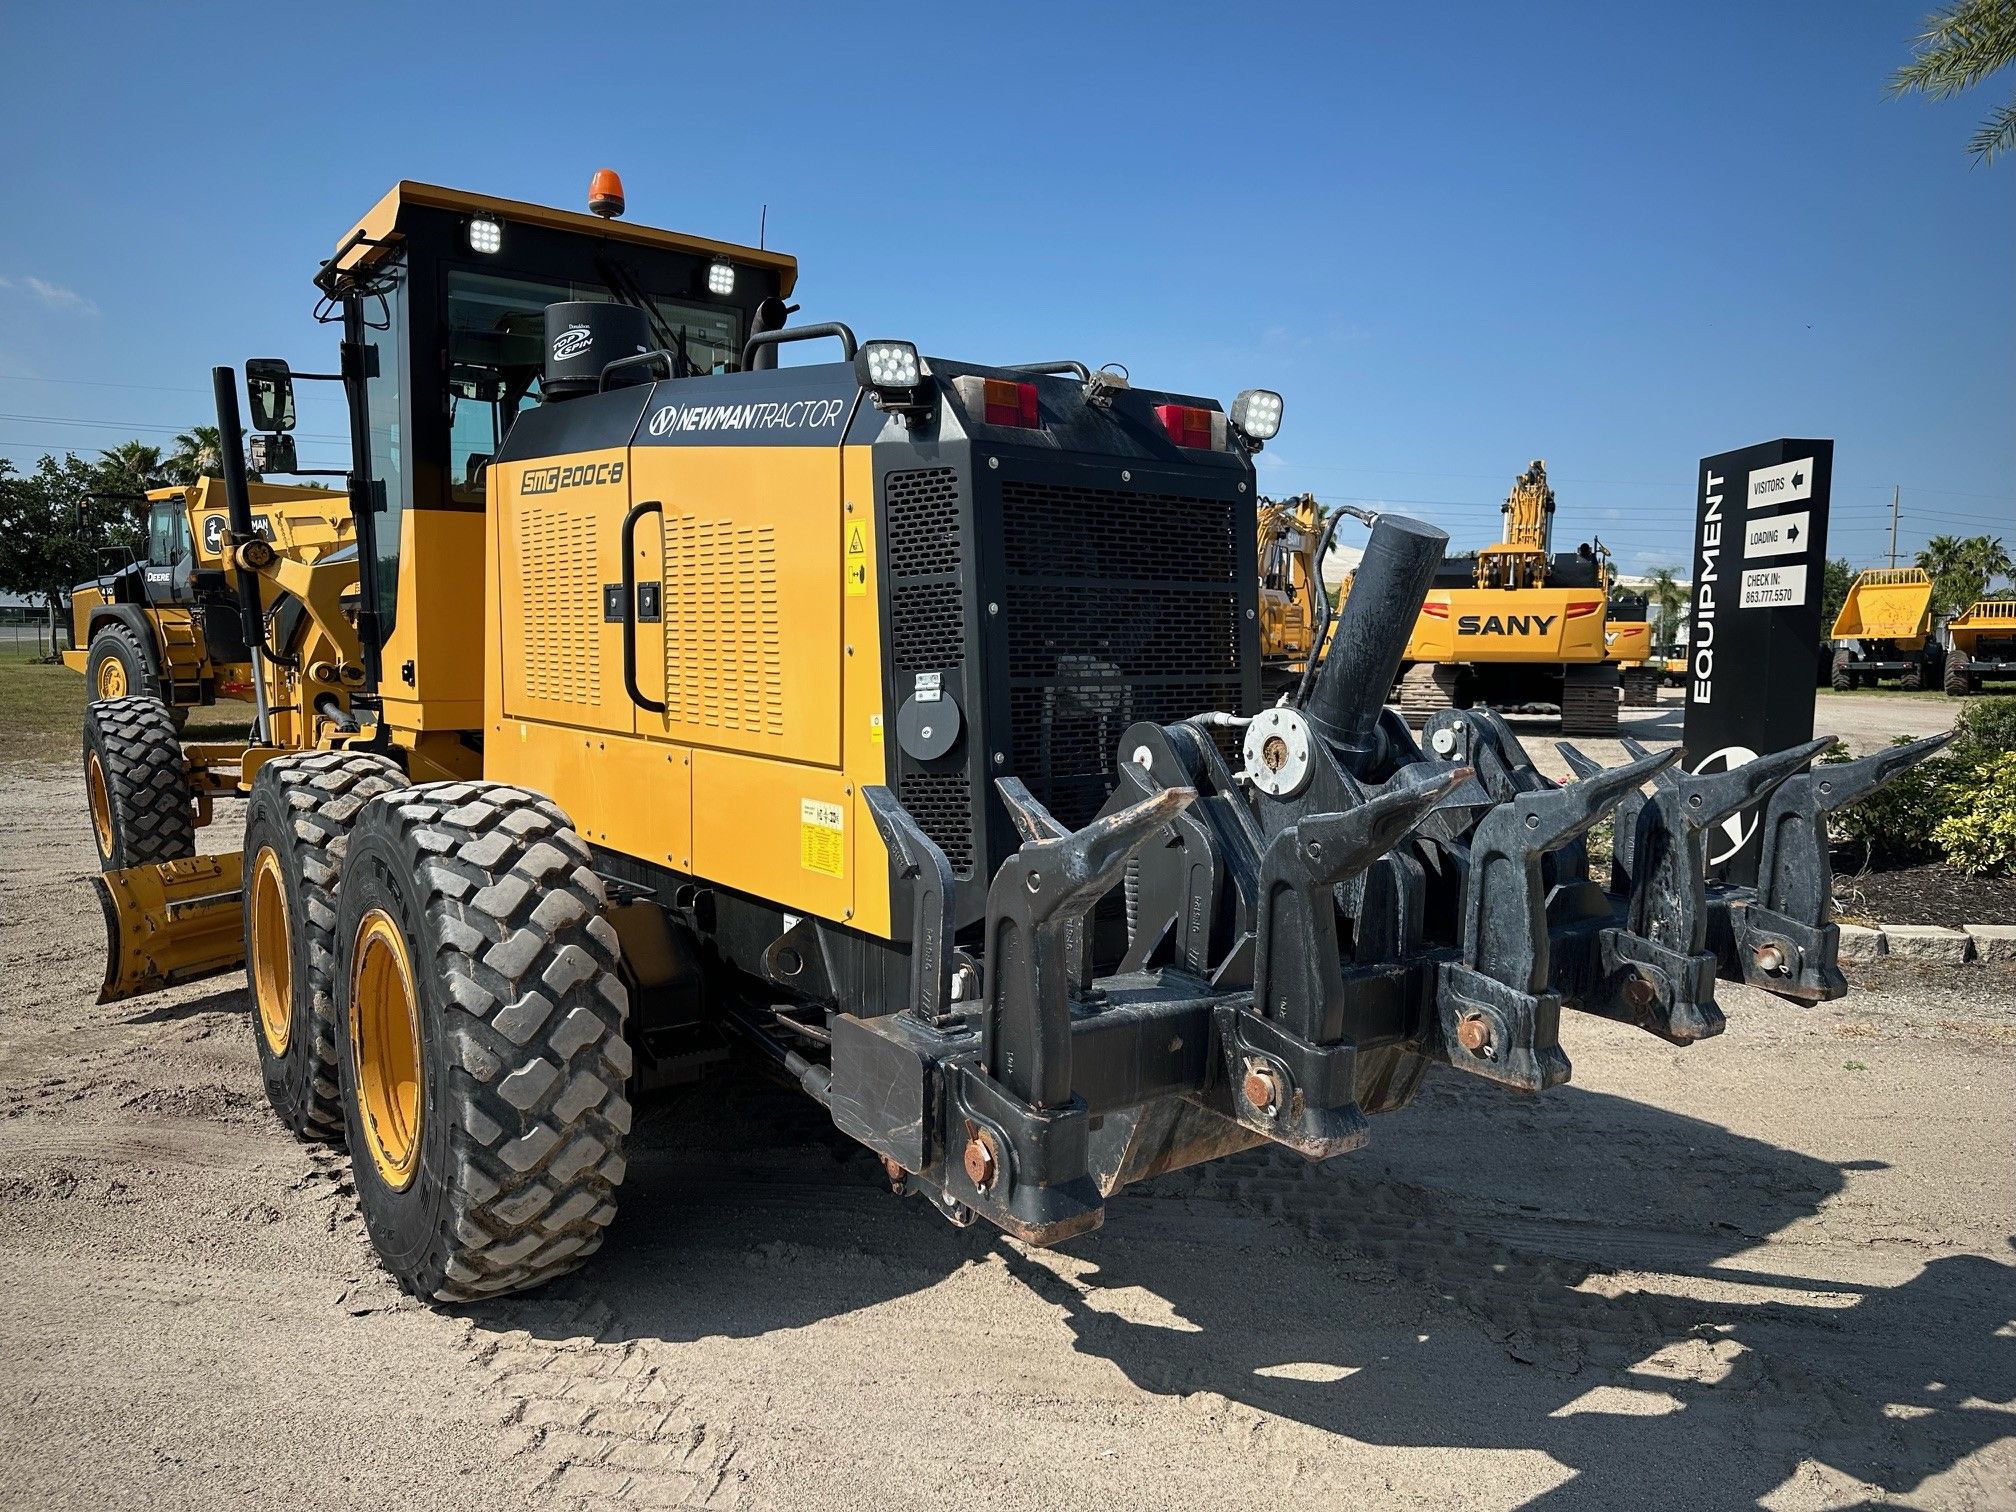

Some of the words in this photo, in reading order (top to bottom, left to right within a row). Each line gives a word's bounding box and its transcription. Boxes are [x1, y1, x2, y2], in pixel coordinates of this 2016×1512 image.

[552, 334, 576, 352] TOP
[564, 338, 594, 355] SPIN
[521, 466, 561, 495] SMG
[1753, 477, 1785, 495] VISITORS
[1750, 529, 1779, 545] LOADING
[147, 572, 171, 583] DEERE
[1747, 573, 1770, 587] CHECK
[1770, 572, 1781, 586] IN:
[1693, 470, 1724, 704] EQUIPMENT
[1745, 588, 1792, 604] 863.777.5570
[1458, 615, 1558, 636] SANY
